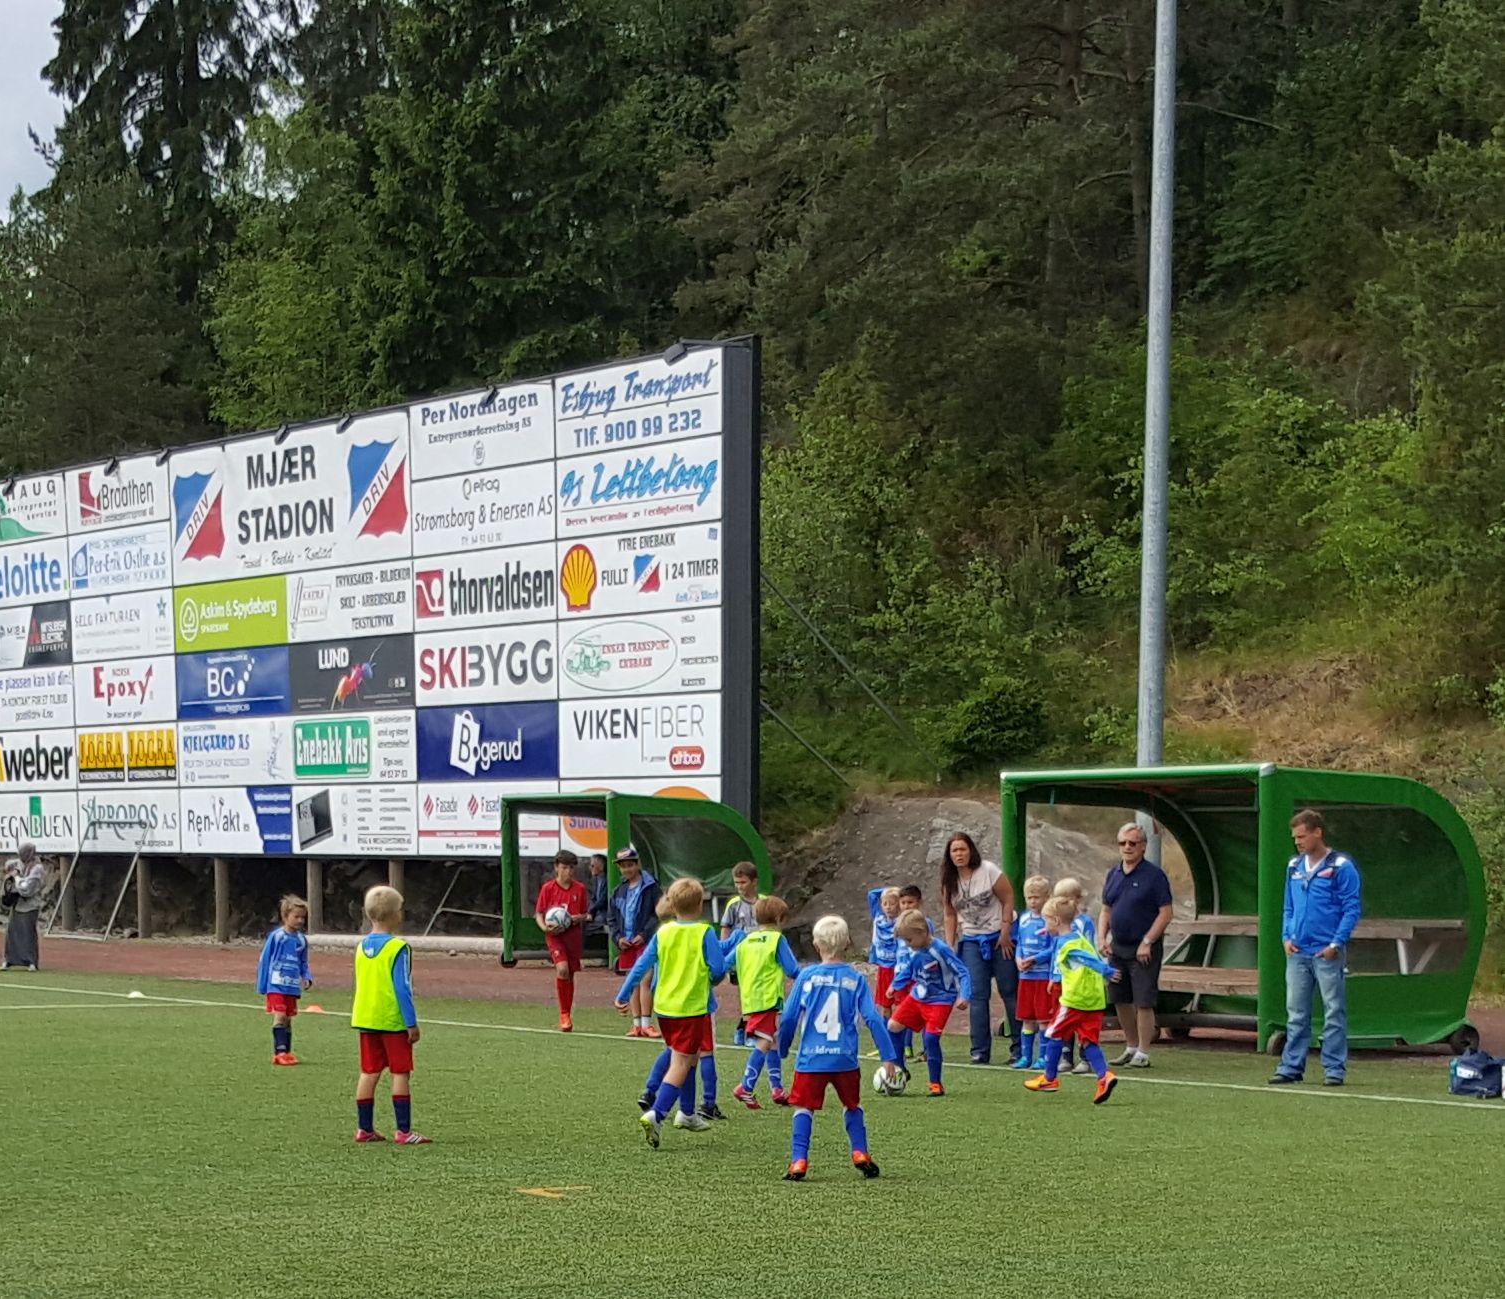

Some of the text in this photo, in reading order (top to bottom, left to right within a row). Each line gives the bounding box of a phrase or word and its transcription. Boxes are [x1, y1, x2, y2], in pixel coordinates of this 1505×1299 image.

[624, 359, 718, 407] Transport
[421, 407, 446, 426] Per
[574, 409, 702, 448] Tlf. 900 99 232
[247, 445, 316, 490] MJÆR
[590, 453, 718, 506] Lettbetong
[102, 478, 154, 510] Braathen
[362, 463, 390, 516] DRIV
[186, 492, 209, 541] DRIV
[238, 497, 334, 545] STADION
[479, 504, 486, 524] &
[490, 502, 534, 523] Enersen
[537, 494, 553, 516] AS
[618, 532, 676, 552] YTRE ENEBAKK
[336, 572, 374, 587] TRYKKSAKER
[449, 561, 554, 616] thorvaldsen
[601, 568, 628, 586] FULLT
[672, 561, 684, 579] 24
[687, 558, 718, 578] TIMER
[200, 596, 277, 620] Askim & Spydeberg
[318, 647, 349, 670] LUND
[628, 640, 670, 652] TRANSPORT
[207, 667, 234, 697] BC
[420, 639, 554, 691] SKIBYGG
[5, 677, 31, 694] plassen
[33, 673, 45, 687] kan
[93, 664, 153, 706] Epoxy
[3, 734, 72, 782] weber
[80, 740, 124, 766] JOGRA
[129, 738, 175, 762] JOGRA
[183, 734, 250, 754] KJELGAARD AS
[296, 725, 369, 766] Enebakk Avis
[458, 723, 522, 770] Bogerud
[187, 798, 240, 833] Ren-Vakt
[814, 990, 841, 1041] 4
